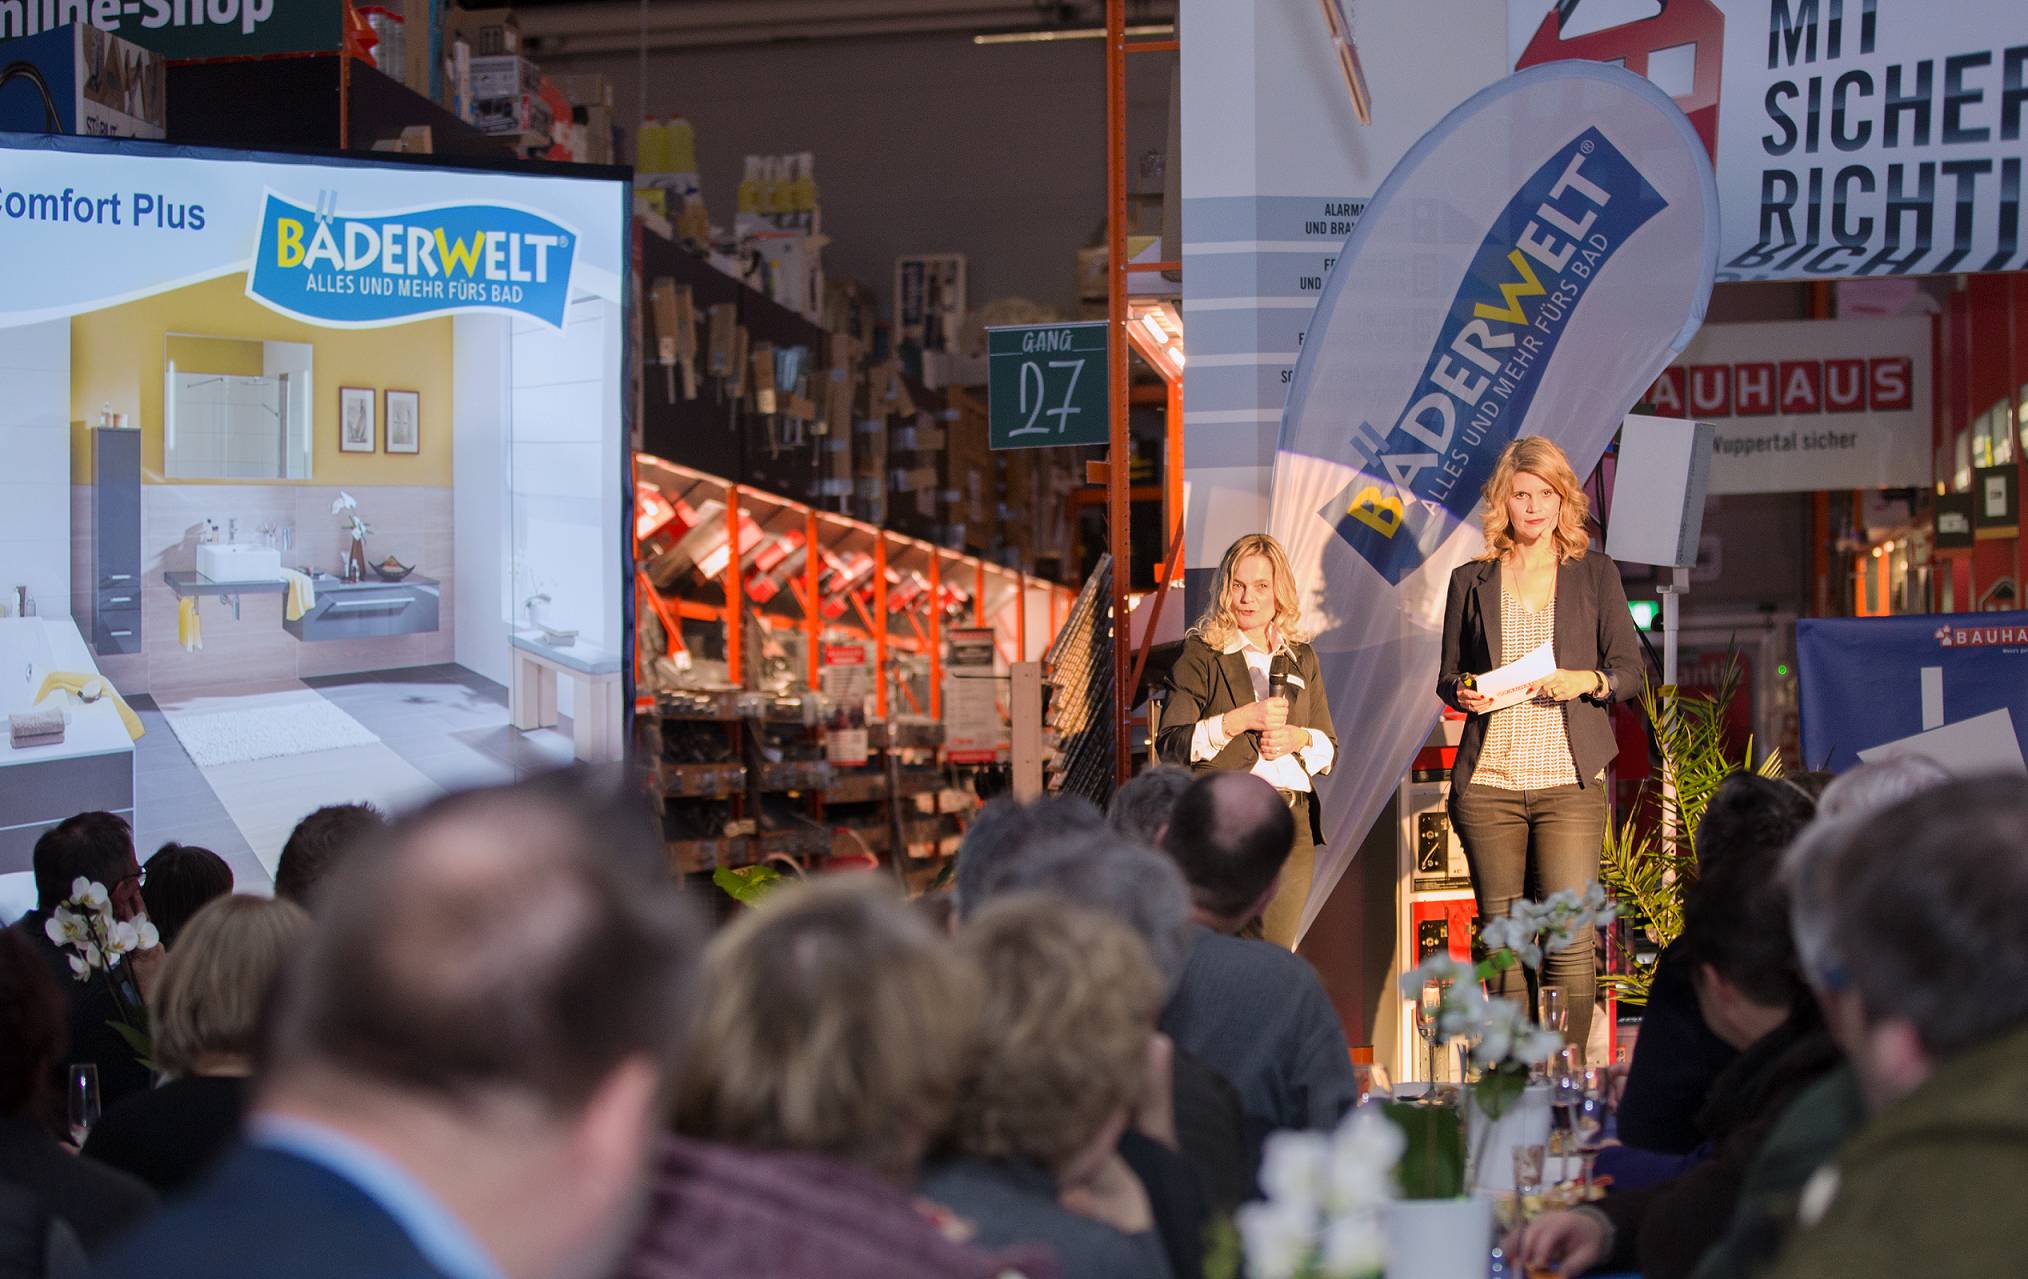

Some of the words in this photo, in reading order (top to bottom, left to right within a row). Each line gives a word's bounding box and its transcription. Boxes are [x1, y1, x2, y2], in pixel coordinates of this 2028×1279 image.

[0, 187, 121, 225] omfort
[133, 192, 206, 231] Plus
[1305, 221, 1327, 235] UND
[1330, 221, 1356, 235] BRA
[306, 273, 354, 294] ALLES
[359, 276, 393, 296] UND
[398, 278, 445, 299] MEHR
[449, 280, 487, 301] FÜRS
[491, 284, 524, 304] BAD
[1299, 276, 1322, 290] UND
[1022, 329, 1074, 353] GANG
[1421, 449, 1469, 517] ALLES
[1462, 401, 1500, 447] UND
[1493, 335, 1544, 400] MEHR
[1535, 279, 1579, 334] FÜRS
[1571, 233, 1608, 279] BAD
[1803, 430, 1858, 449] sicher
